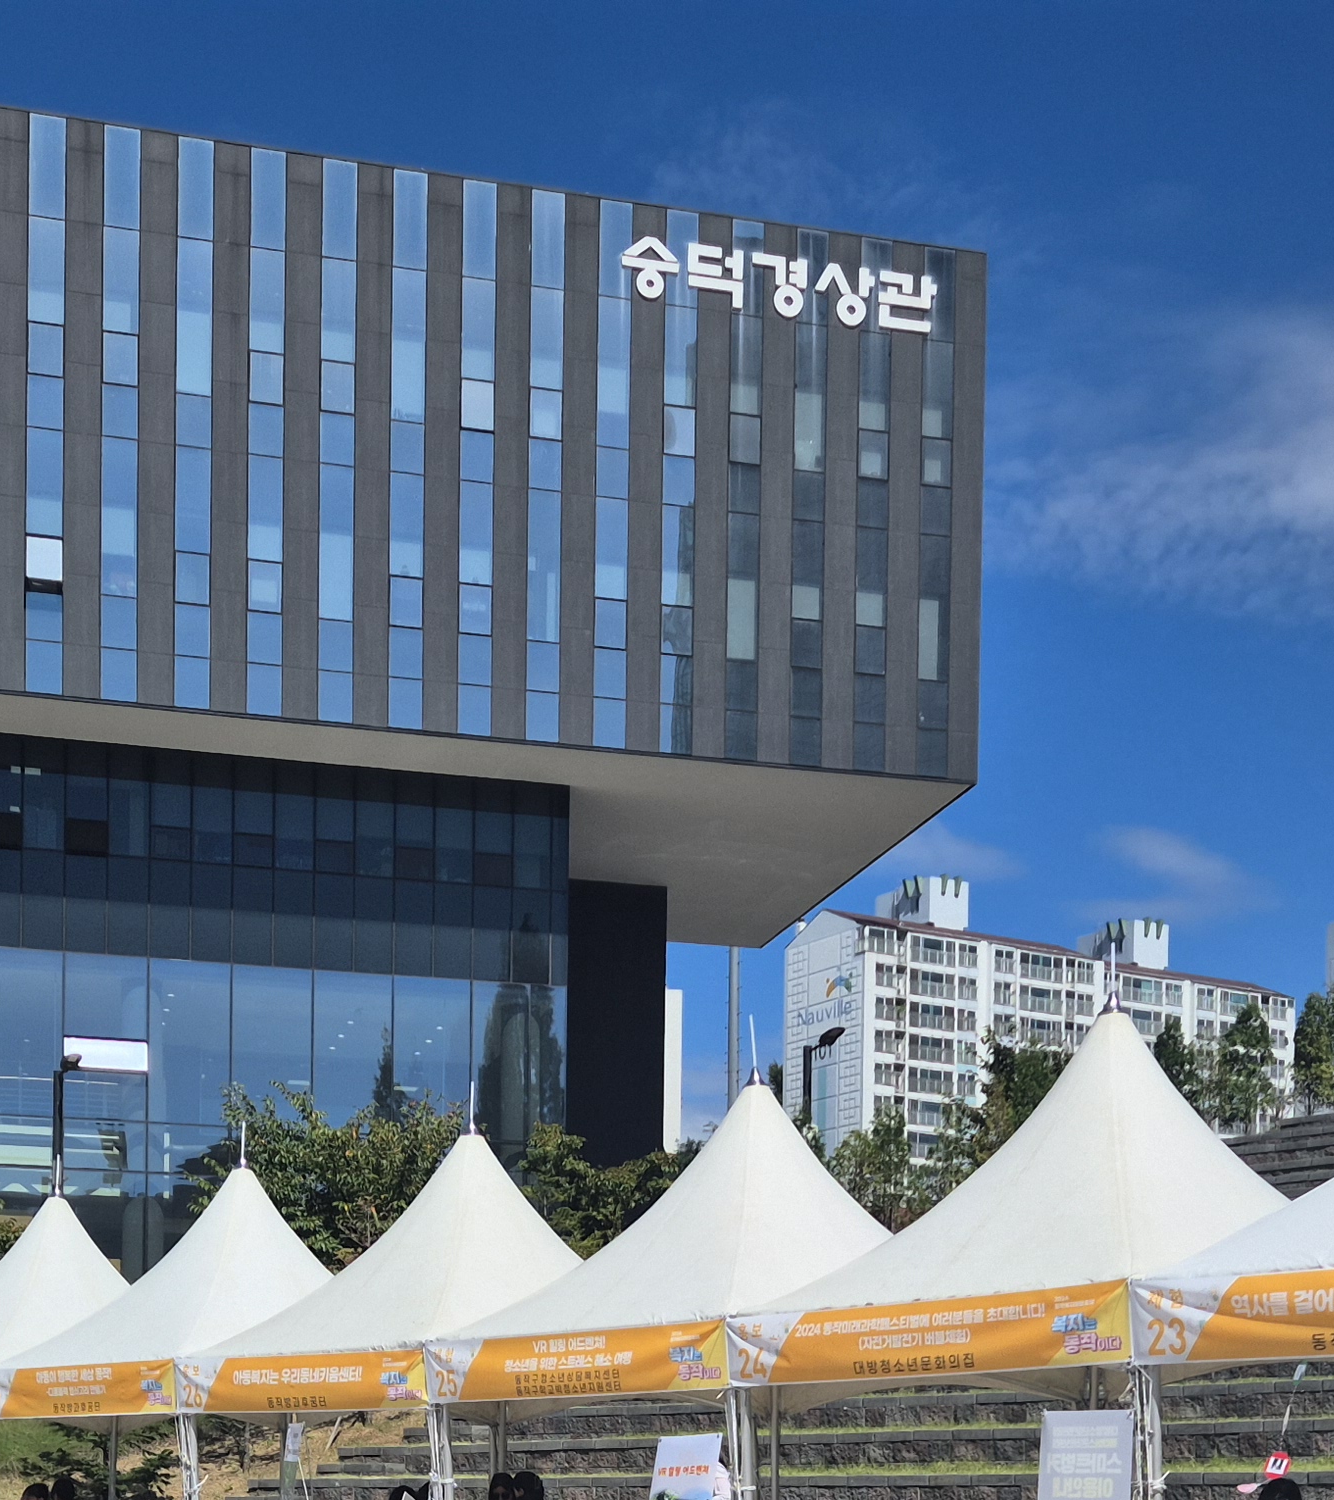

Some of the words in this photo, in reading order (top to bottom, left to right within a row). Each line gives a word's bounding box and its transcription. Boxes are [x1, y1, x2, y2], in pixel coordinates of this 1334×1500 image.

[621, 235, 937, 334] 숭덕경상관
[1230, 1292, 1288, 1318] 역사를
[794, 1323, 822, 1338] 2024
[931, 1308, 984, 1327] 여러분들을
[986, 1302, 1046, 1322] 초대합니다!
[1051, 1313, 1098, 1333] 복지는
[532, 1339, 547, 1353] VR
[549, 1338, 566, 1353] 힐링
[1063, 1332, 1123, 1355] 동작이다
[1147, 1317, 1187, 1356] 23
[504, 1357, 538, 1373] 청소년을
[539, 1356, 558, 1372] 위한
[558, 1353, 593, 1371] 스트레스
[669, 1346, 703, 1363] 복지는
[738, 1347, 768, 1380] 24
[853, 1353, 975, 1376] 대방청소년문화의집
[232, 1367, 280, 1385] 아동복지는
[281, 1366, 363, 1384] 우리동네키움센터!
[435, 1369, 458, 1398] 25
[182, 1384, 203, 1408] 26
